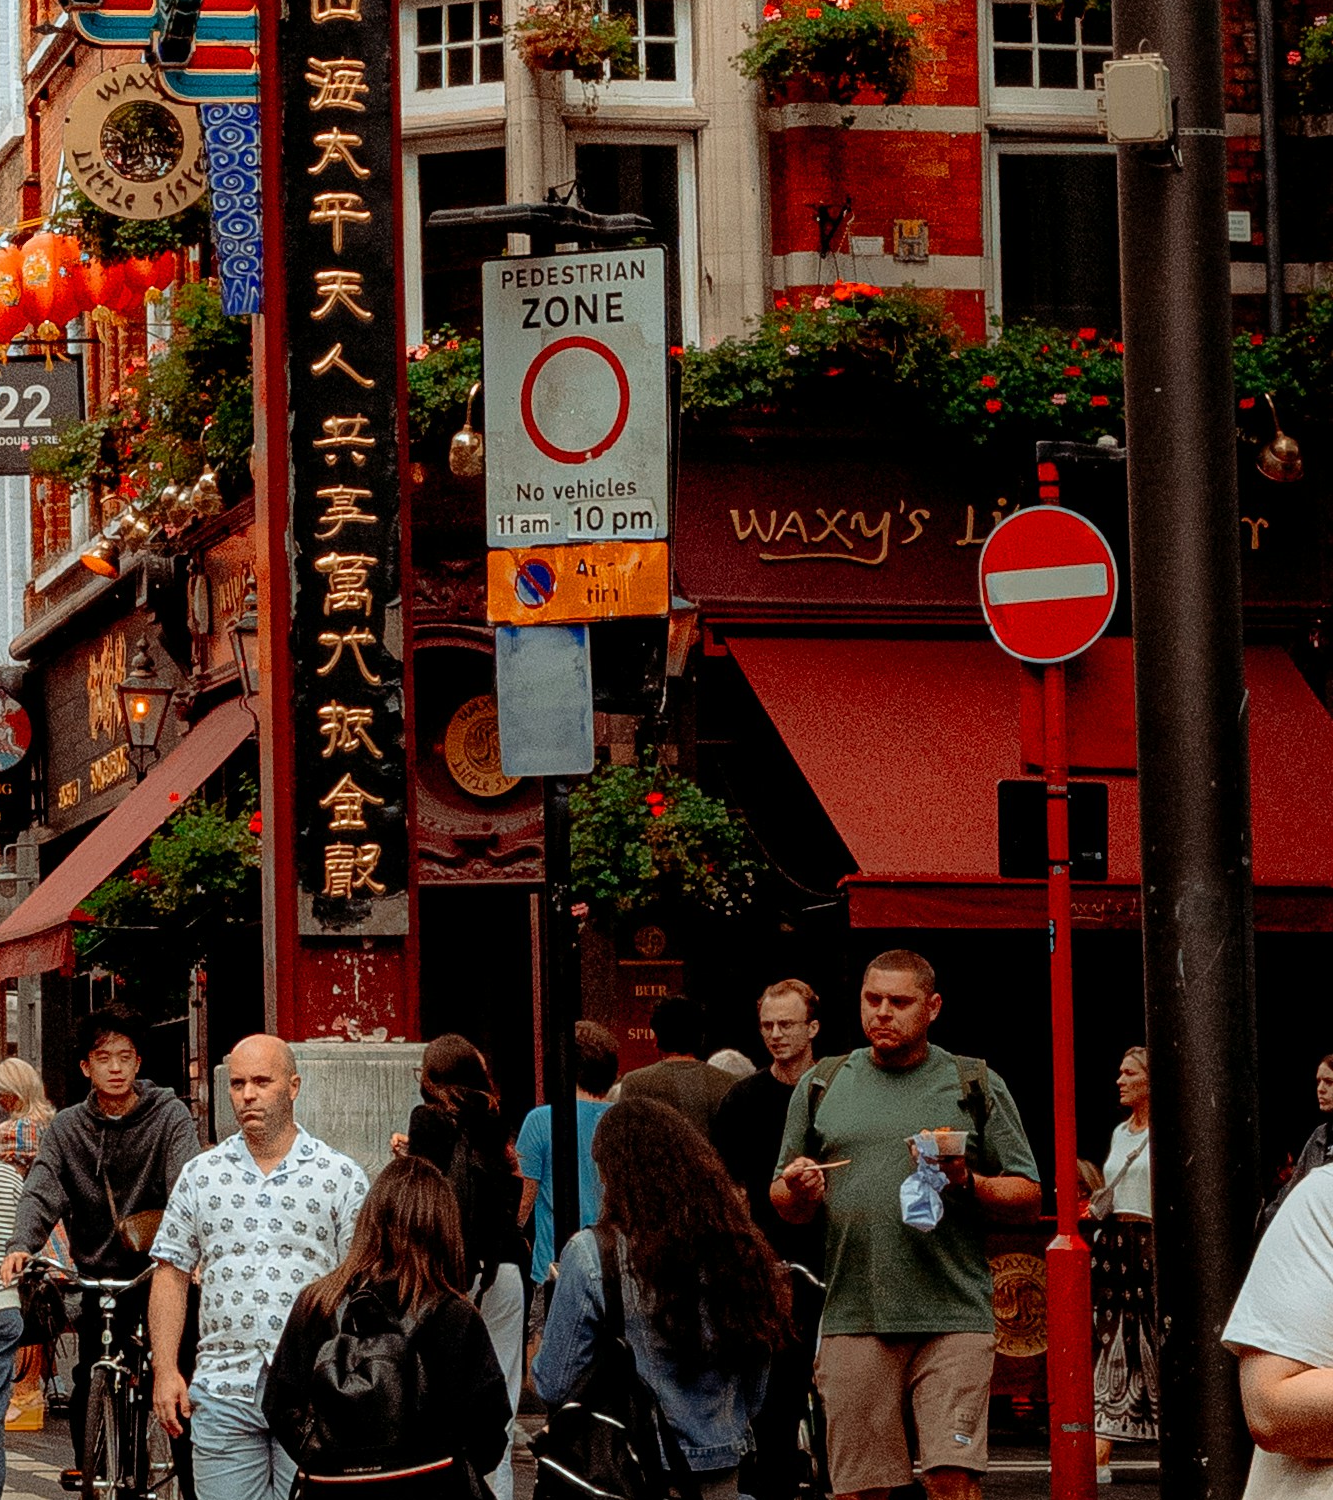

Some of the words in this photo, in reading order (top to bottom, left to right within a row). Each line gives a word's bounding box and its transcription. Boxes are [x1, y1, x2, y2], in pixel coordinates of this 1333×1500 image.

[501, 260, 646, 290] PEDESTRIAN
[522, 291, 625, 328] ZONE
[516, 482, 545, 502] No
[553, 478, 637, 500] vehicles
[497, 515, 515, 534] 11
[520, 518, 550, 534] am
[574, 505, 604, 532] 10
[613, 510, 654, 537] pm
